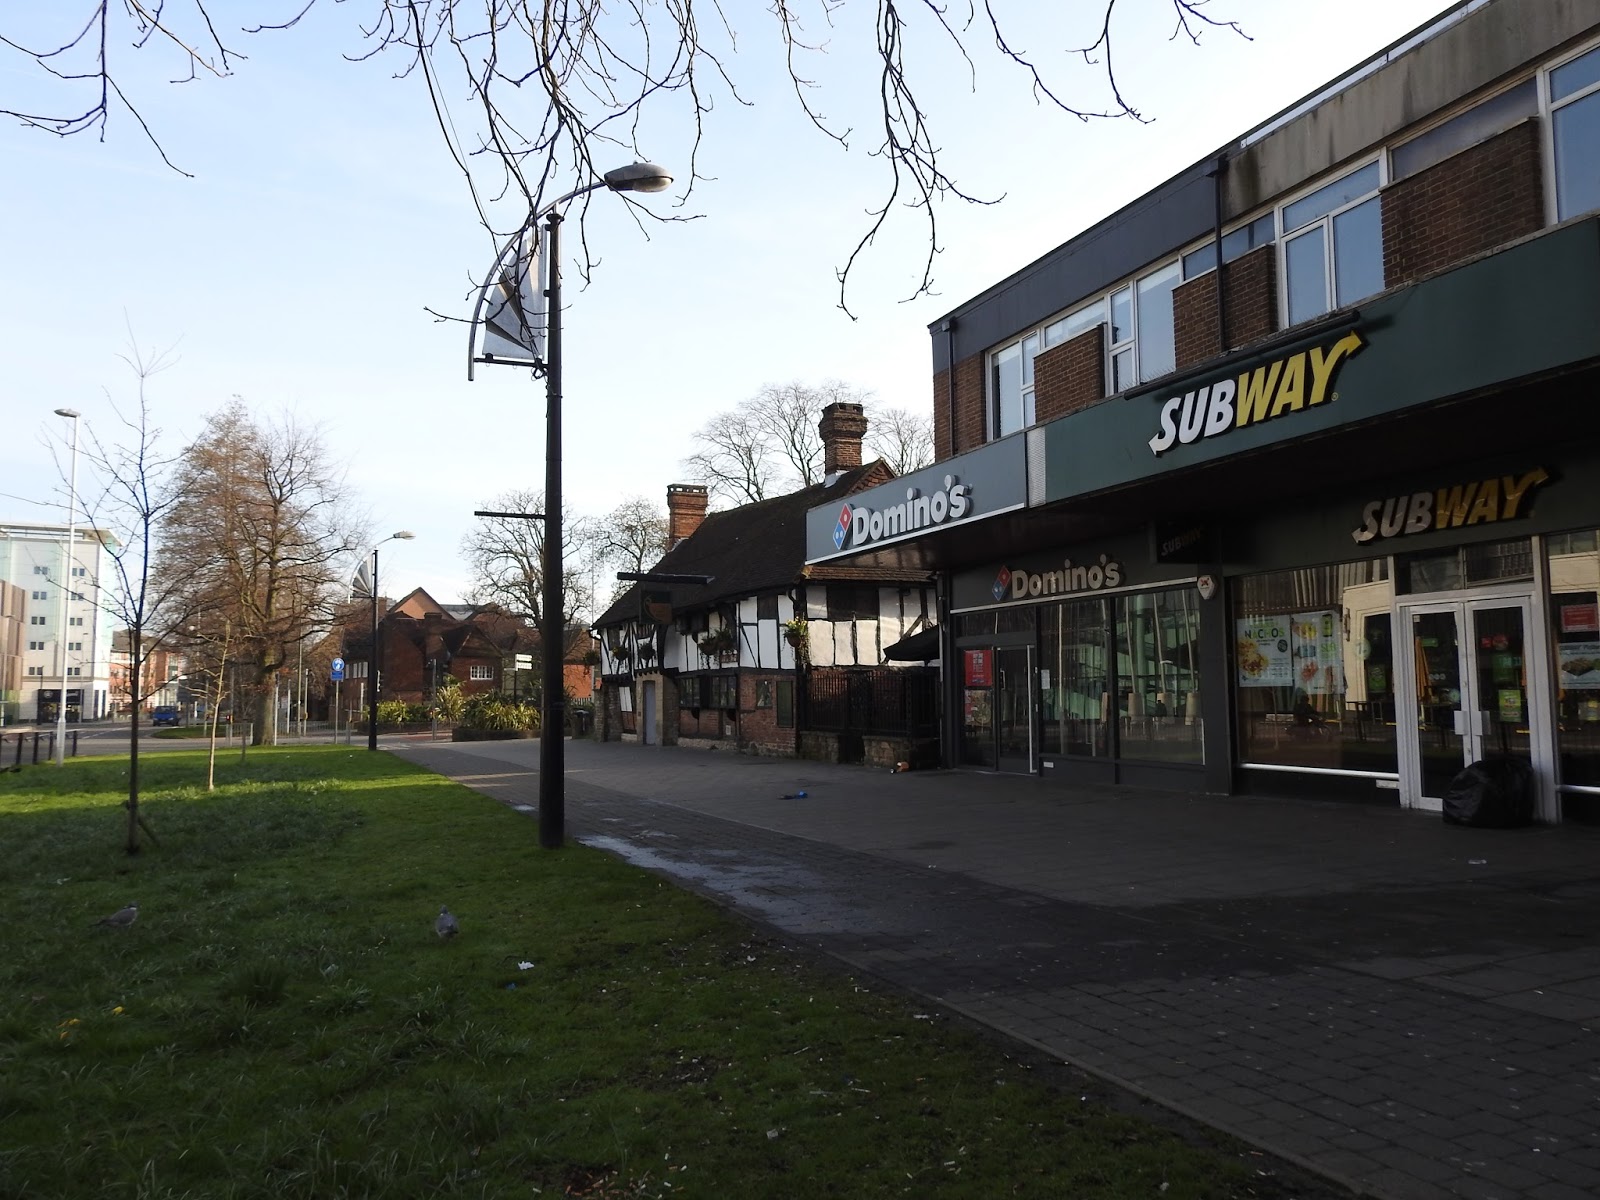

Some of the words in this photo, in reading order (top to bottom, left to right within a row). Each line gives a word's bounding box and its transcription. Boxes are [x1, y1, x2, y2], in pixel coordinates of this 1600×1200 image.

[1148, 331, 1362, 456] SUBWAY
[852, 474, 967, 546] Domino's
[1351, 466, 1549, 543] SUBWAY
[1011, 554, 1120, 599] Domino's
[1244, 627, 1285, 640] NACHOS
